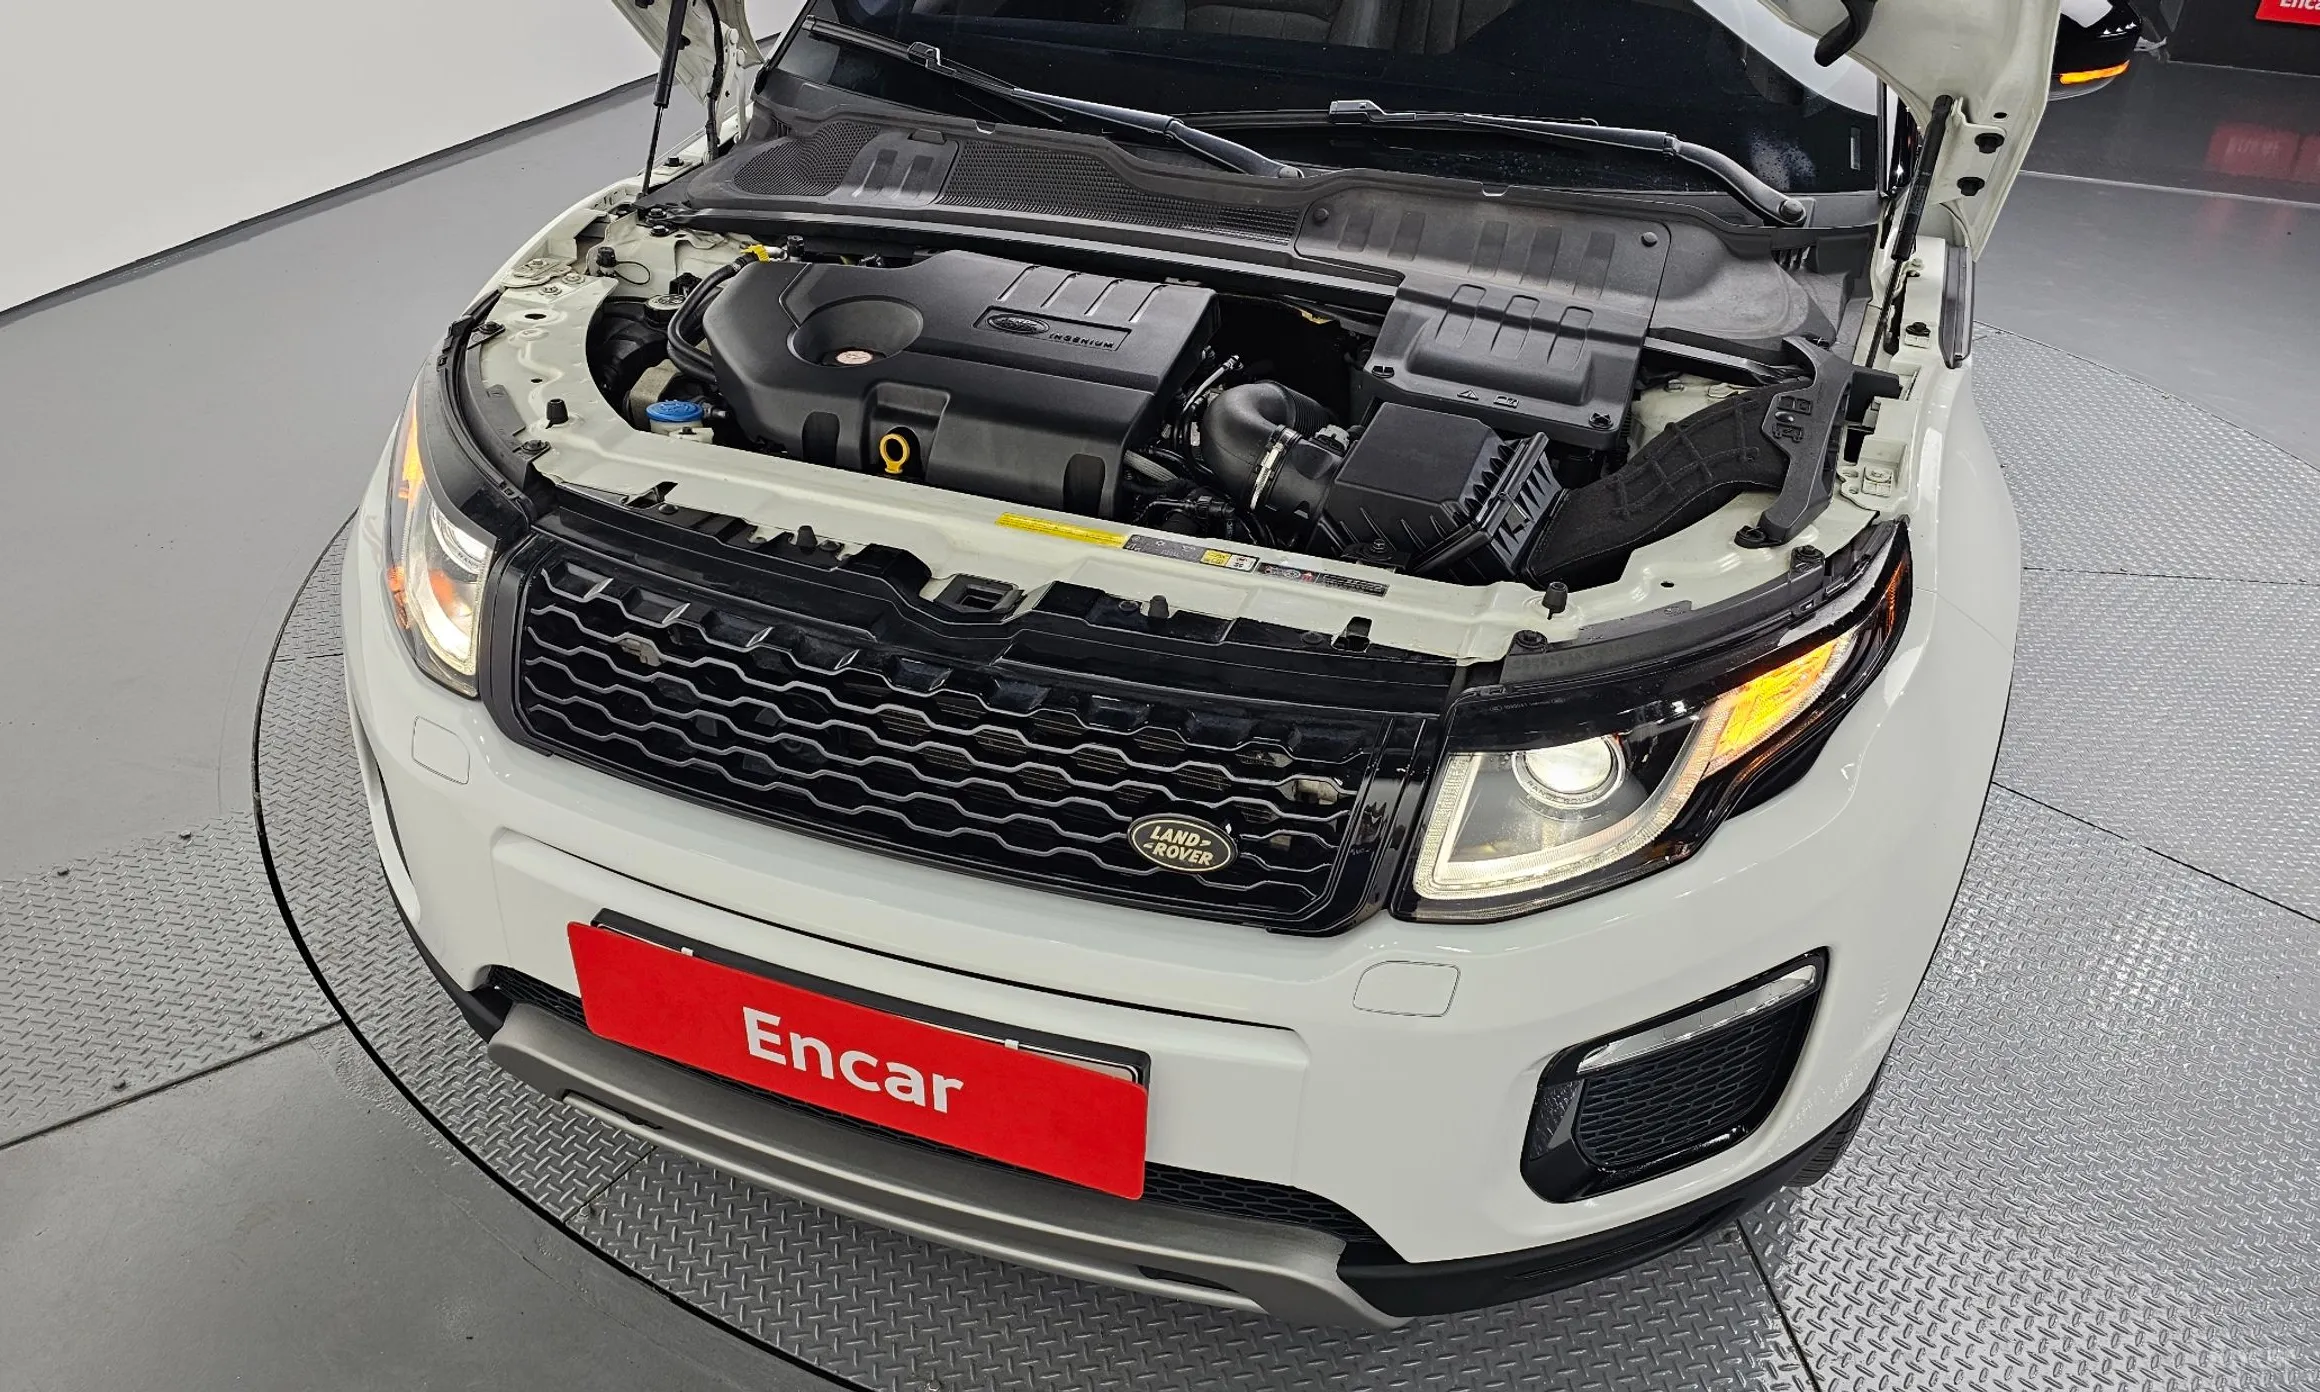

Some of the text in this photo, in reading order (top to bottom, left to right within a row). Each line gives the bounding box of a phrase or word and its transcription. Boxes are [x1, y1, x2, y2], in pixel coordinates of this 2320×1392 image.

[1150, 825, 1201, 847] LAND
[1152, 842, 1214, 866] ROVER
[742, 1006, 965, 1114] Encar
